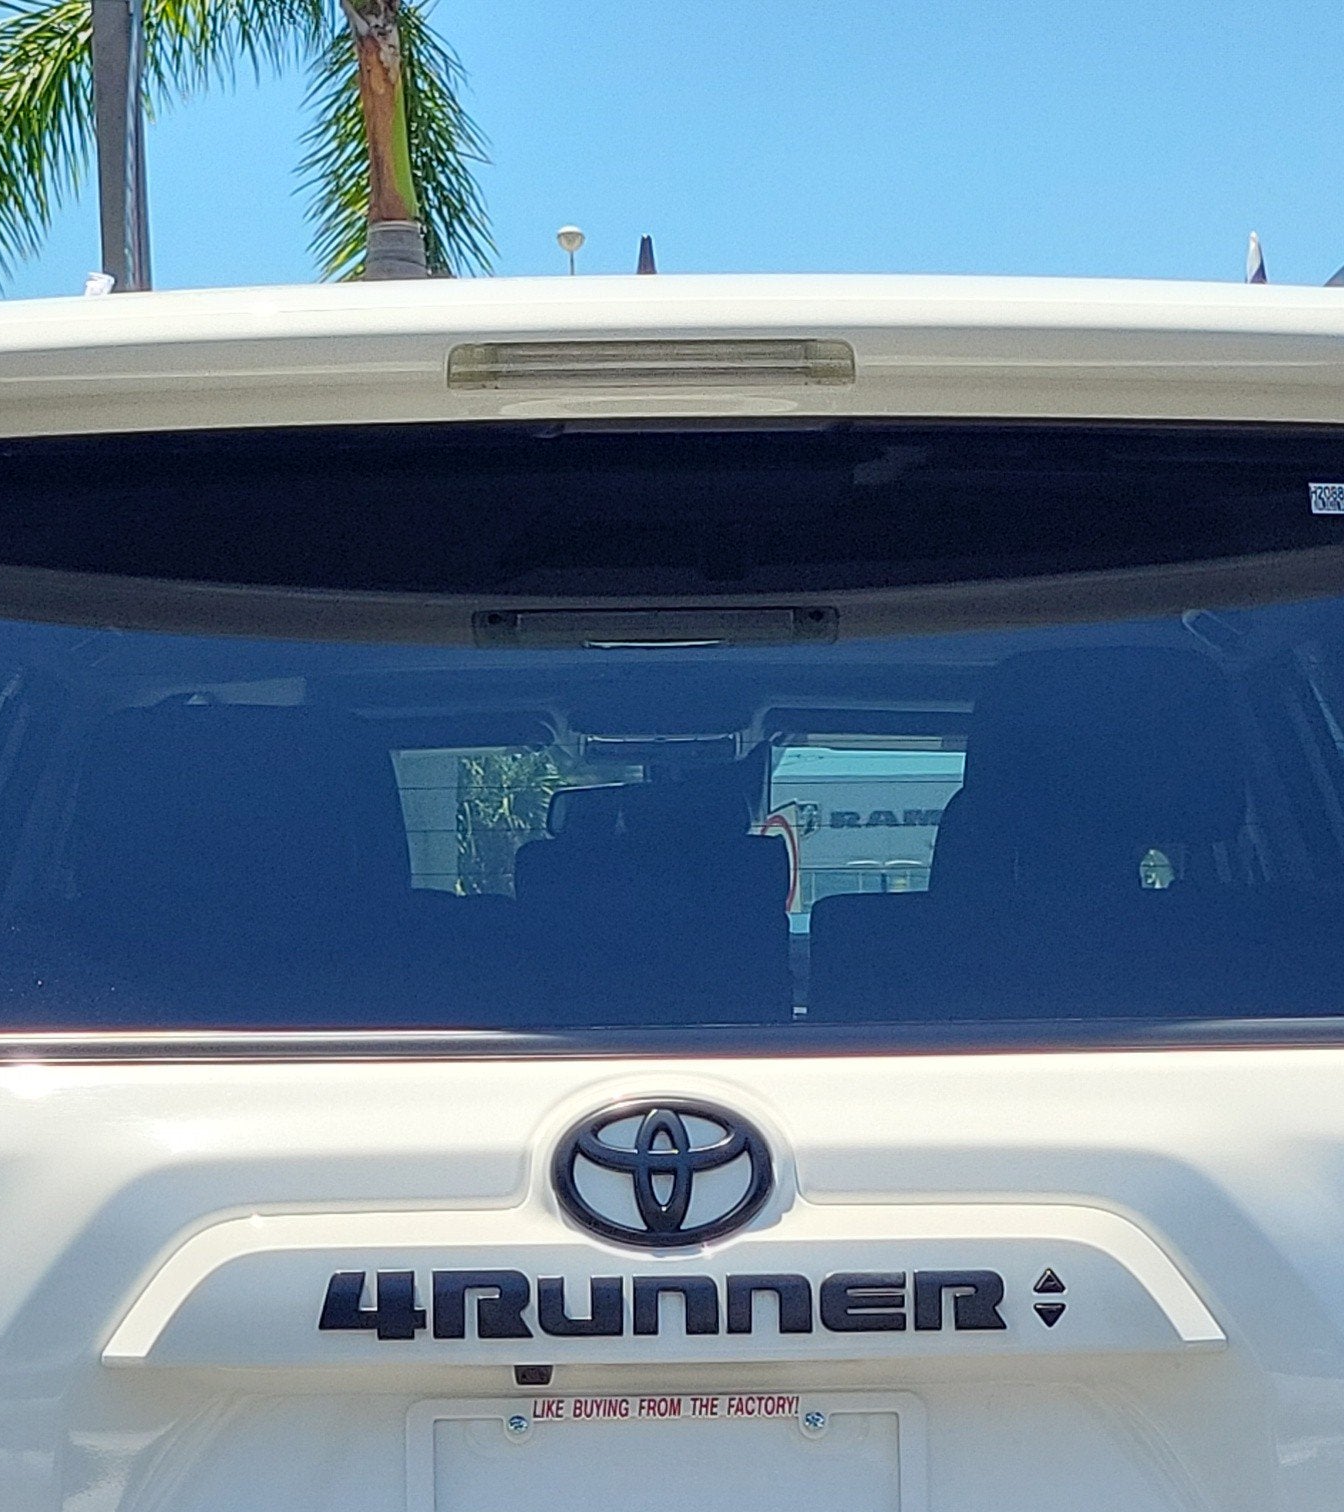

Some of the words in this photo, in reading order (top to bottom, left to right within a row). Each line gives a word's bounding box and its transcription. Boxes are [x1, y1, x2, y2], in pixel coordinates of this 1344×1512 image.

[318, 1269, 1007, 1340] 4RUNNER
[533, 1399, 565, 1419] LIKE
[573, 1398, 630, 1418] BUYING
[638, 1398, 681, 1417] FROM
[690, 1396, 719, 1416] THE
[727, 1396, 800, 1416] FACTORY!
